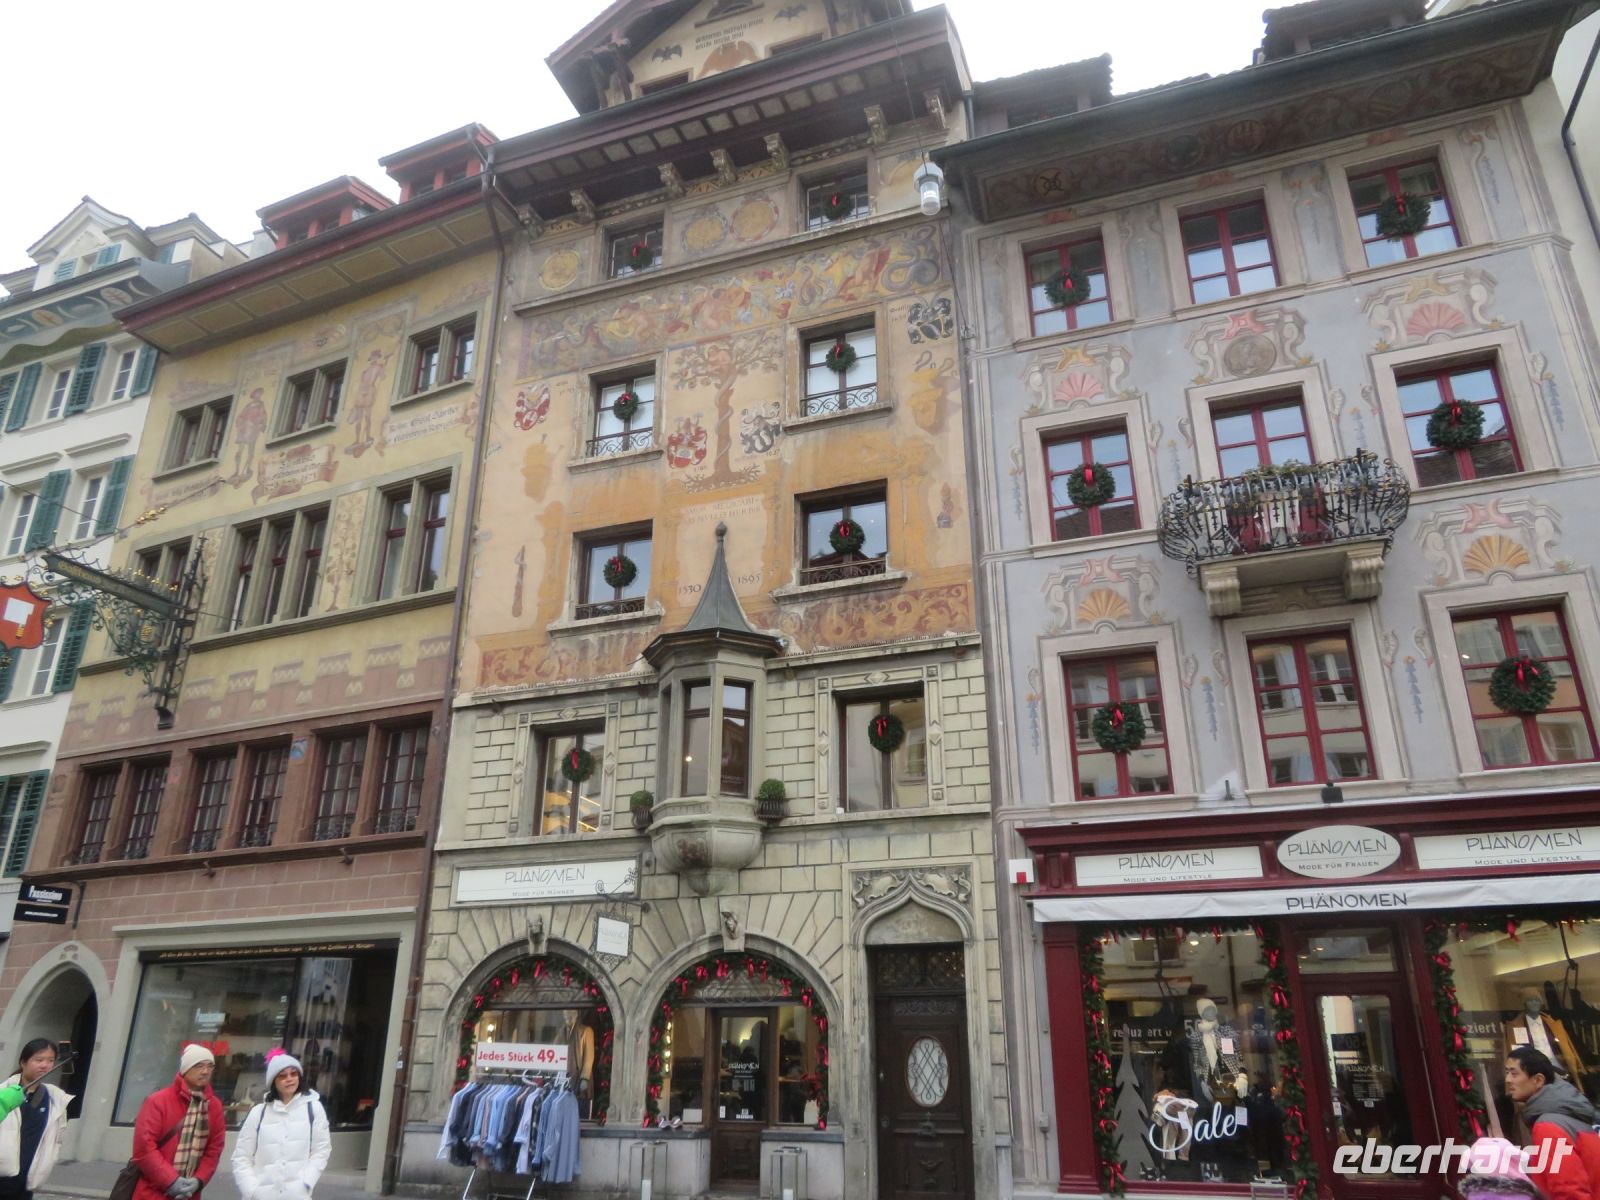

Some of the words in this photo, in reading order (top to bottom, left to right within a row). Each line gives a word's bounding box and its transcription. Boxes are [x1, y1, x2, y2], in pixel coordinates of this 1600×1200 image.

[1287, 834, 1388, 857] PHÄNOMEN
[1286, 892, 1408, 911] PHÄNOMEN
[478, 1050, 505, 1061] Jedes
[508, 1051, 534, 1063] Stück
[1149, 1097, 1238, 1153] Sale
